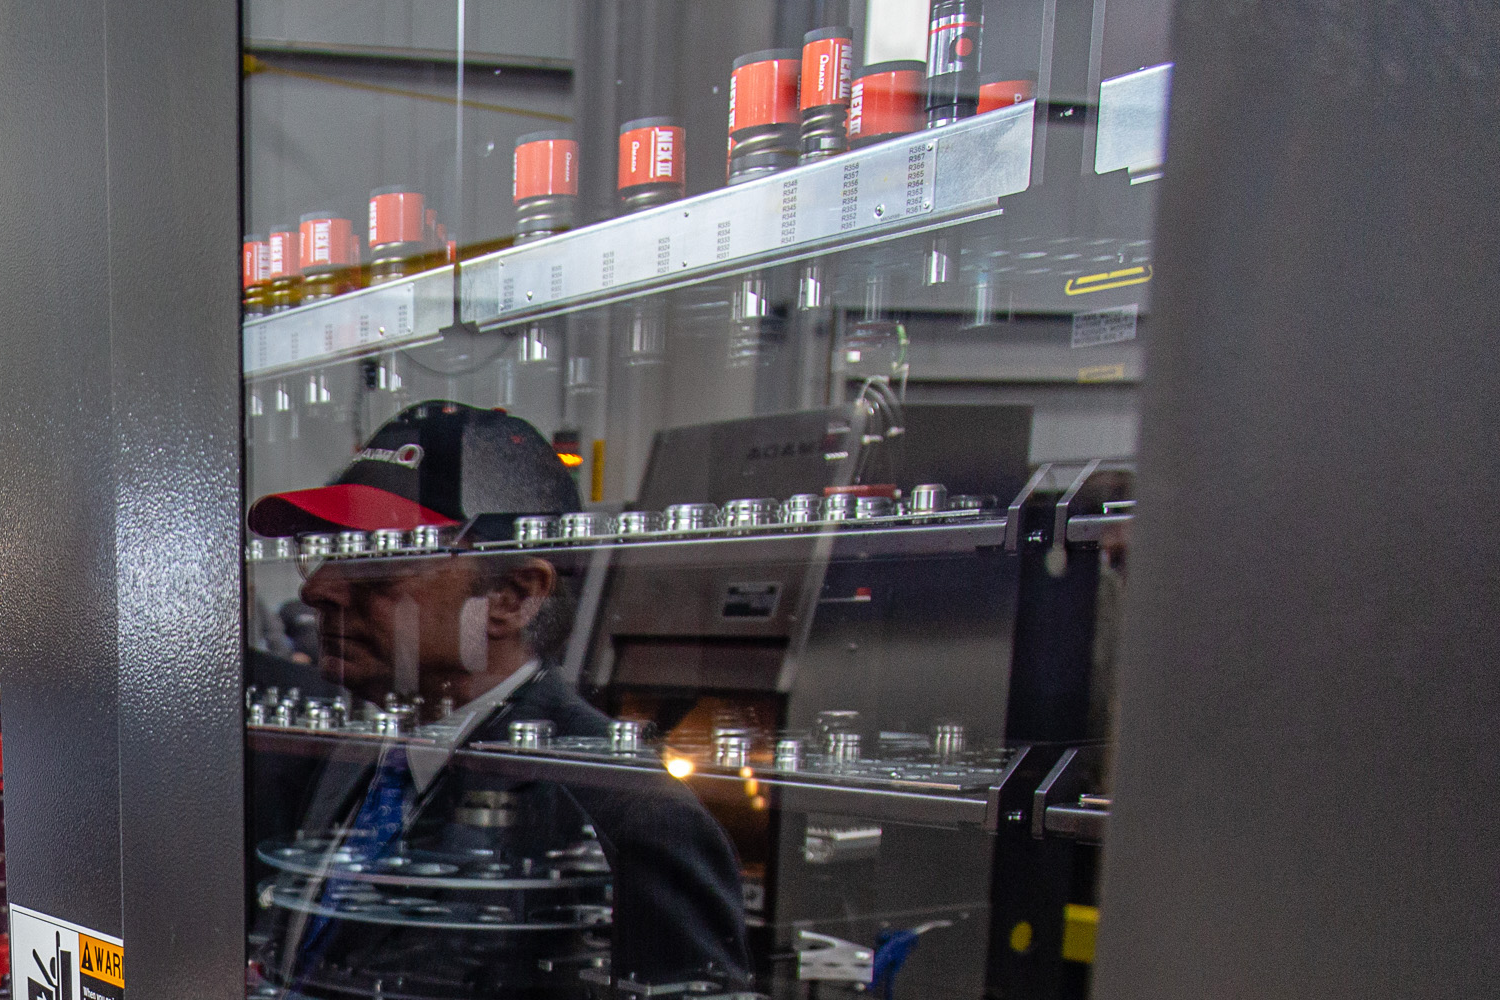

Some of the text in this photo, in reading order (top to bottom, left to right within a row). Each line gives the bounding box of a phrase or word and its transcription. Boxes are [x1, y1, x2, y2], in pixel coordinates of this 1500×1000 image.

[909, 144, 926, 154] R368
[909, 153, 925, 163] R367
[845, 163, 860, 172] R358
[909, 162, 925, 171] R366
[844, 171, 859, 180] R357
[908, 171, 924, 180] R365
[784, 180, 798, 189] R348
[843, 180, 858, 188] R356
[908, 180, 924, 189] R364
[783, 188, 797, 196] R347
[843, 188, 858, 197] R355
[907, 188, 923, 197] R363
[783, 196, 797, 205] R346
[842, 196, 857, 205] R354
[907, 197, 923, 206] R362
[783, 204, 796, 212] R345
[842, 204, 857, 213] R353
[906, 206, 922, 215] R361
[782, 212, 796, 220] R344
[842, 213, 856, 221] R352
[782, 220, 796, 228] R343
[841, 221, 856, 230] R351
[781, 228, 795, 236] R342
[781, 236, 795, 244] R341
[83, 987, 96, 1000] When
